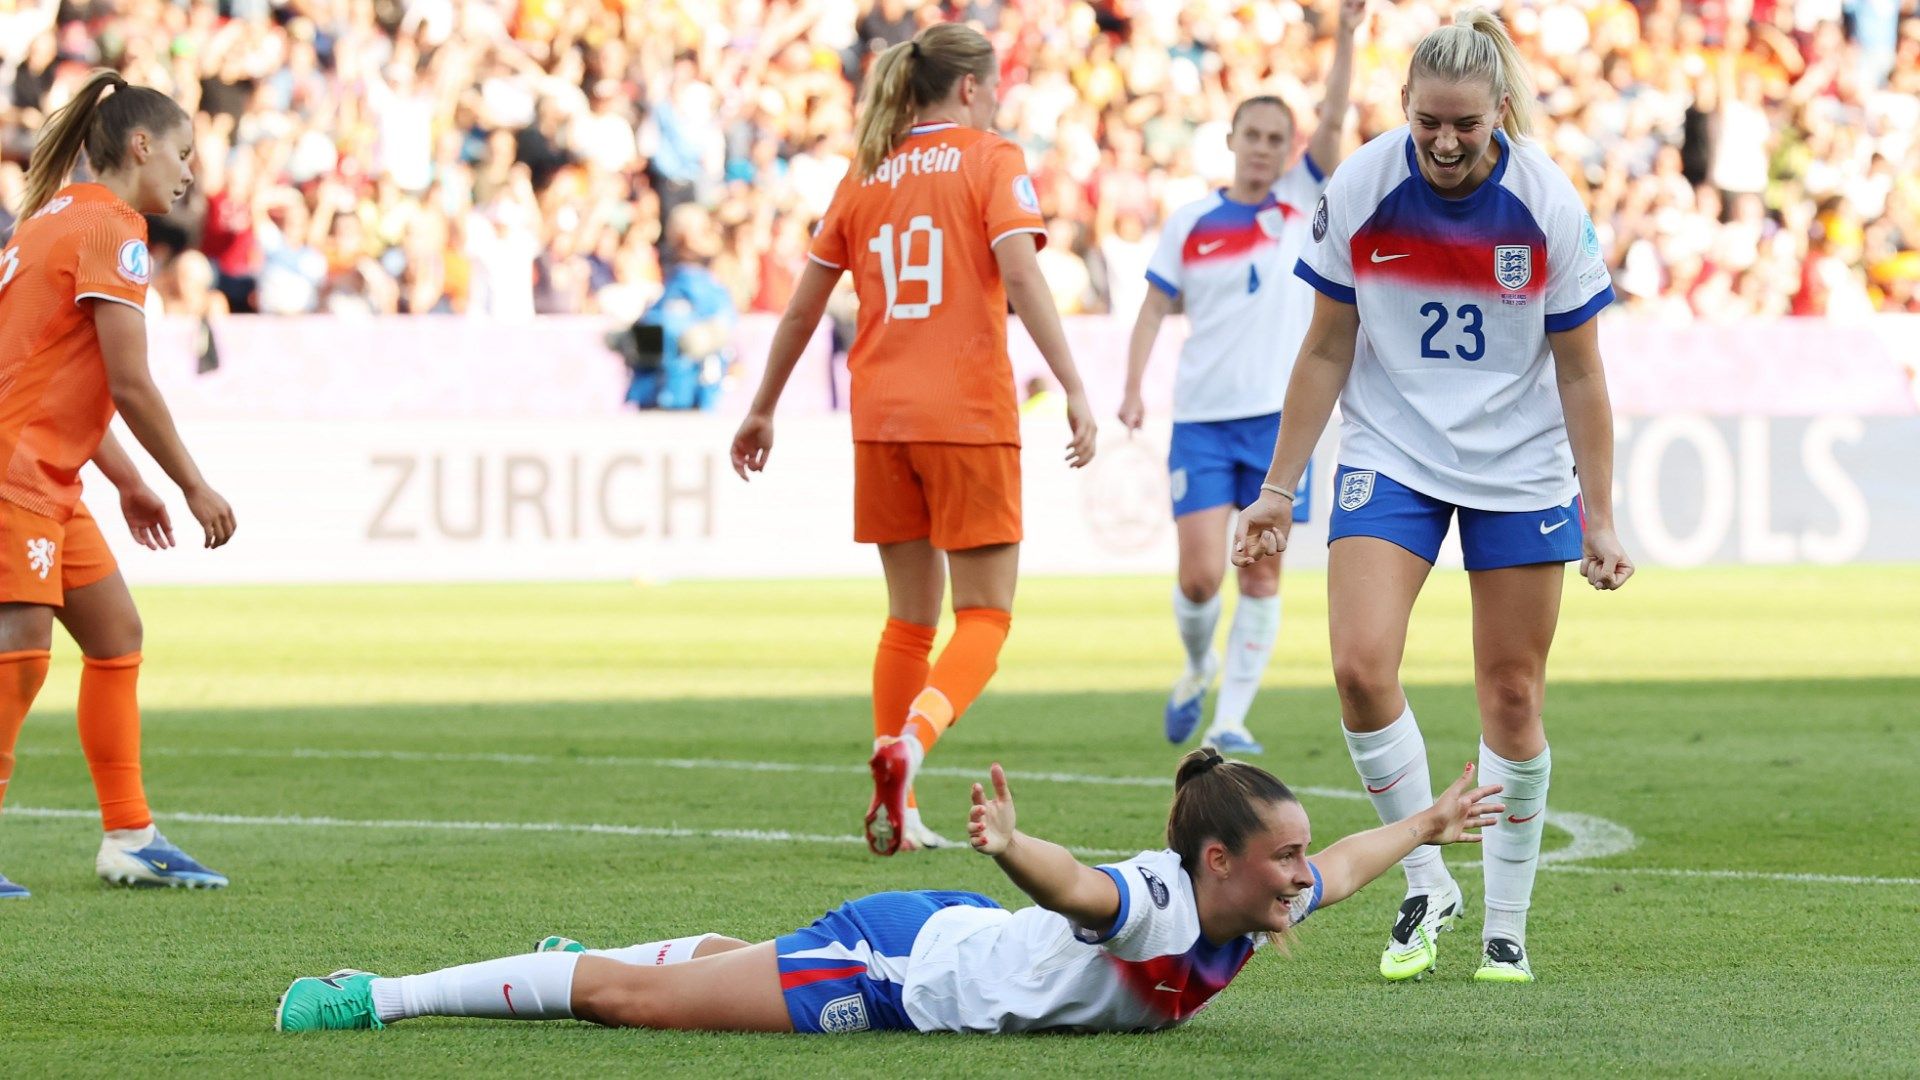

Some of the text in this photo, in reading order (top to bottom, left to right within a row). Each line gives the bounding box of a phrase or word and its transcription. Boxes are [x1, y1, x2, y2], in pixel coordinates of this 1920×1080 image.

[868, 215, 943, 324] 19
[1420, 302, 1485, 361] 23
[367, 453, 714, 540] ZURICH
